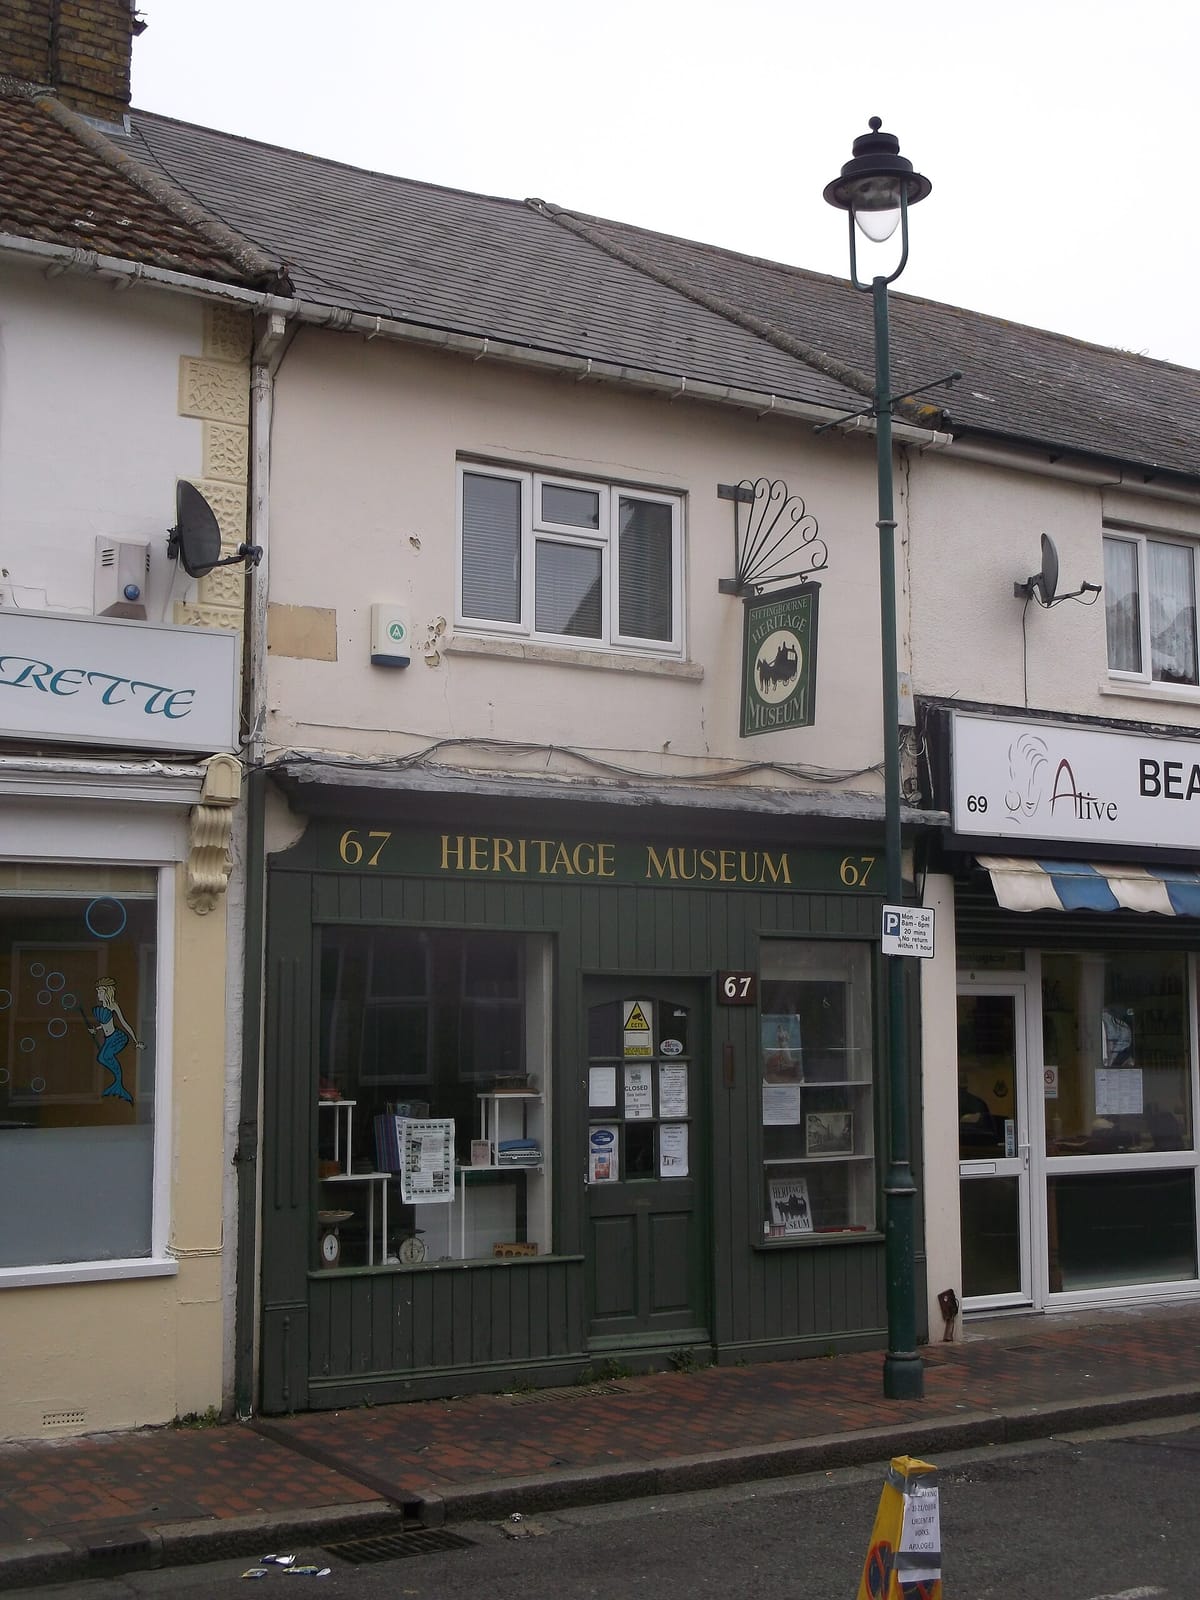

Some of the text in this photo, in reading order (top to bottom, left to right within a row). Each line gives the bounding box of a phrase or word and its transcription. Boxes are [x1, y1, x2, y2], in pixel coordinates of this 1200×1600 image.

[752, 613, 807, 644] HERITAGE
[0, 656, 196, 719] RETTE
[748, 688, 805, 730] MUSEUM
[967, 795, 988, 813] 69
[1049, 758, 1118, 821] Alive
[339, 830, 875, 886] 67 HERITAGE MUSEUM 67
[887, 913, 899, 933] P
[920, 914, 930, 922] Sat
[724, 976, 752, 998] 67
